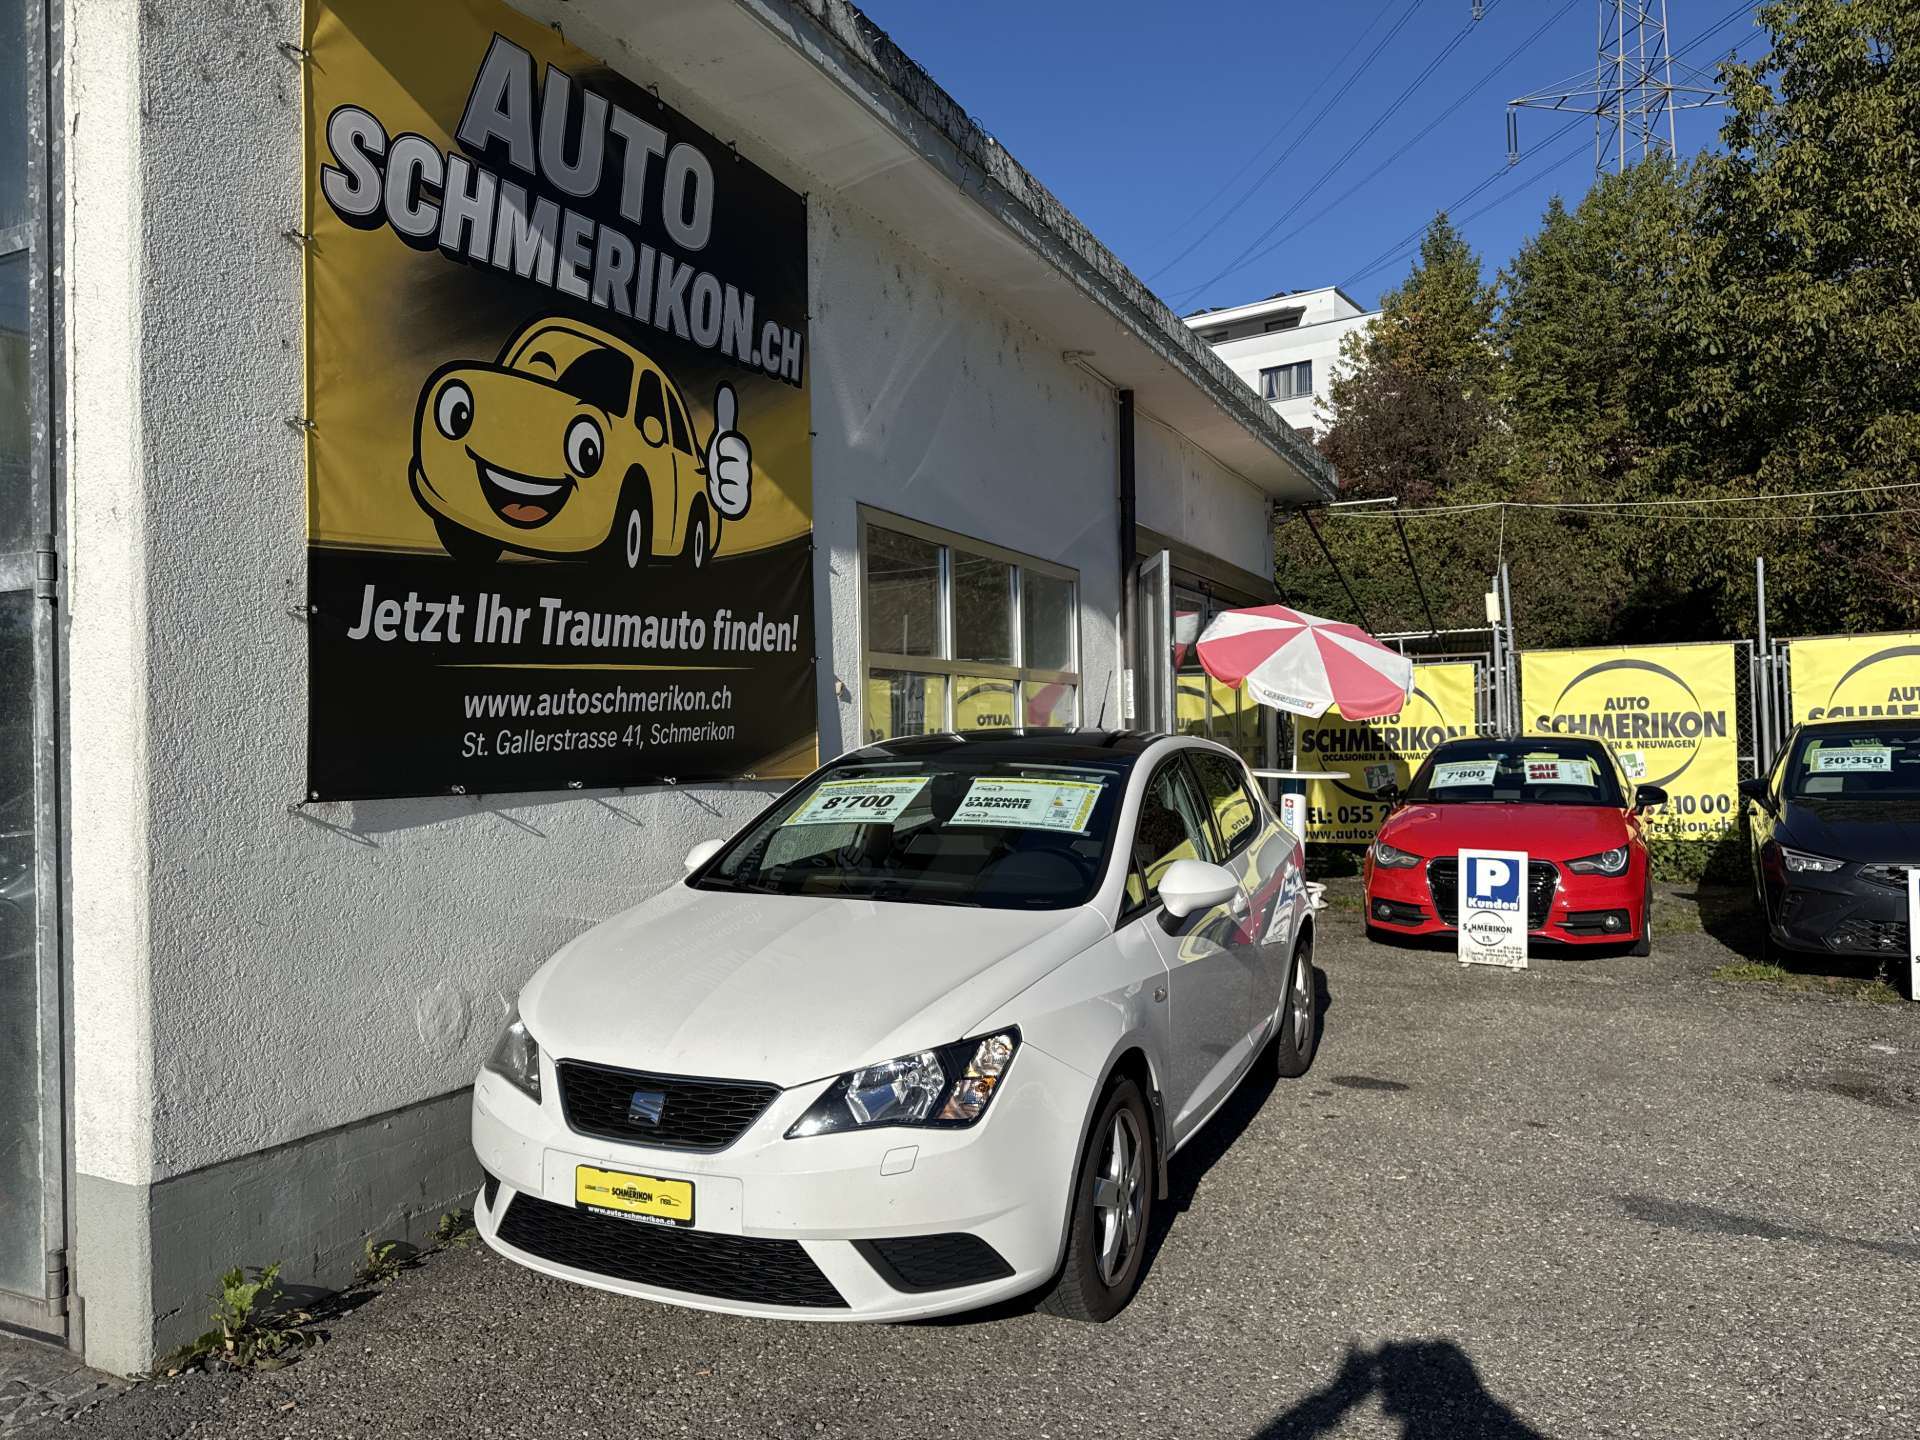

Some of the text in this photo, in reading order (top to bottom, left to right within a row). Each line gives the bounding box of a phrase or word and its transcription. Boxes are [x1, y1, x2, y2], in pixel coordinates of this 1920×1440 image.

[456, 33, 716, 252] AUTO
[322, 106, 804, 389] SCHMERIKON.CH
[347, 584, 799, 653] Jetzt Ihr Traumauto finden!
[464, 685, 732, 719] www.autoschmerikon.ch
[1888, 687, 1920, 702] AU
[1604, 696, 1650, 711] AUTO
[462, 721, 735, 758] St. Gallerstrasse 41, Schmerikon
[1626, 740, 1634, 749] &
[1637, 739, 1696, 750] NEUWAGEN
[1322, 753, 1376, 762] OCCASIONEN
[1388, 752, 1428, 761] NEUWAG
[1824, 756, 1884, 765] 20'350
[1447, 769, 1485, 780] 7'800
[1529, 763, 1559, 772] SALE
[1529, 772, 1560, 780] SALE
[822, 795, 895, 810] 8'700
[965, 802, 1030, 810] GARANTIE
[982, 796, 1032, 804] MONATE
[1307, 806, 1333, 824] EL:
[1337, 805, 1374, 824] 055
[1475, 858, 1510, 896] P
[611, 1187, 653, 1201] SCHMERIKON
[588, 1206, 676, 1226] www.auto-schmerikon.ch
